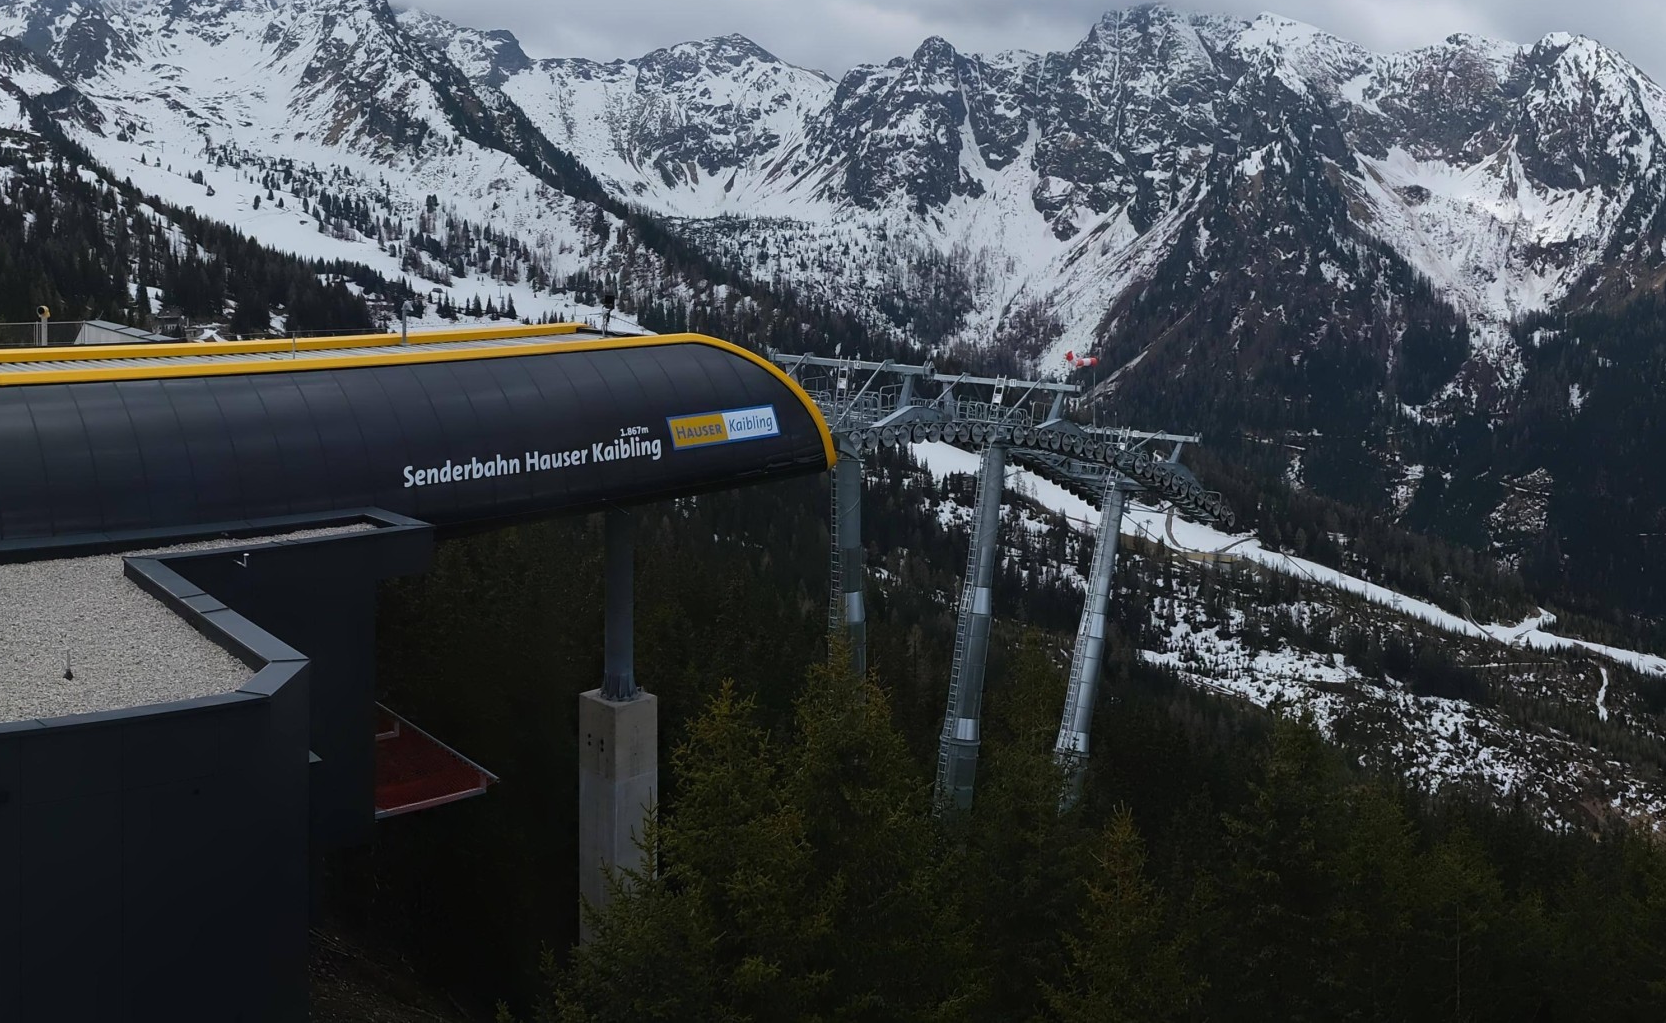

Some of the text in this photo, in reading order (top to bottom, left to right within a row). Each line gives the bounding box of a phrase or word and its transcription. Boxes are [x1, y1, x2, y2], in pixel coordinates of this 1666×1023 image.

[620, 426, 649, 437] 1.867m
[675, 414, 773, 439] HAUSER Kaibling
[403, 436, 662, 488] Senderbahn Hauser Kaibling
